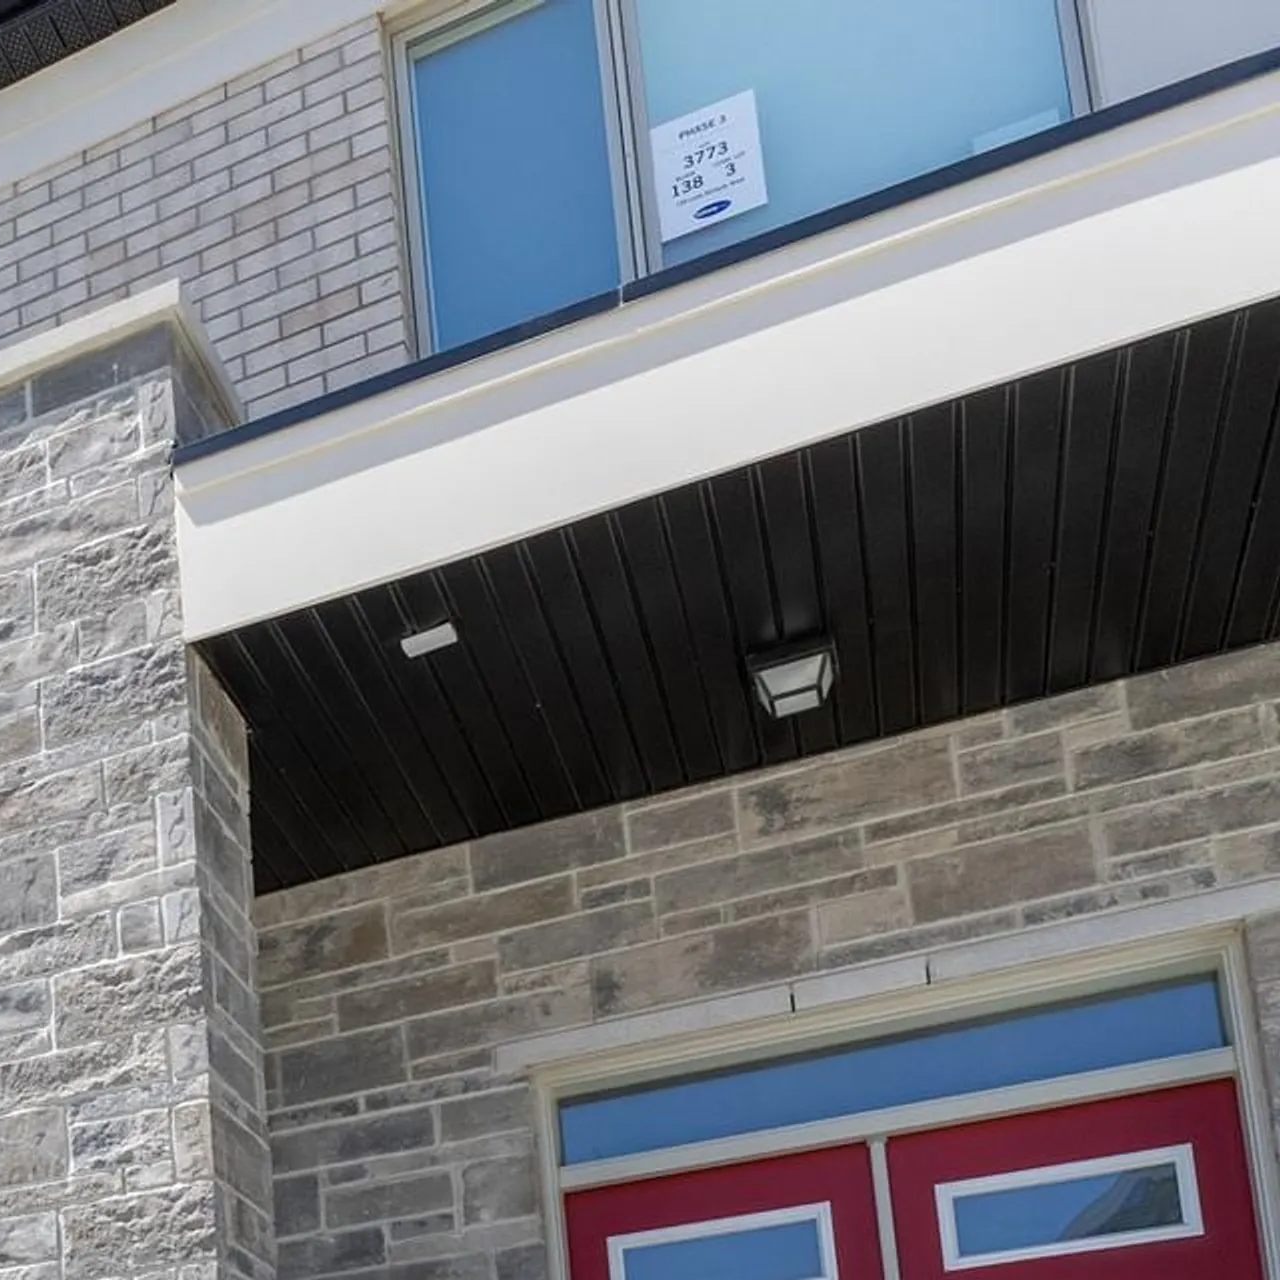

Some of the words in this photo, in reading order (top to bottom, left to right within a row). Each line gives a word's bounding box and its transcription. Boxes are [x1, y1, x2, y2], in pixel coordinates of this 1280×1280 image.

[678, 117, 715, 139] PHASE
[683, 140, 729, 169] 3773
[671, 174, 704, 198] 138
[724, 162, 736, 177] 3
